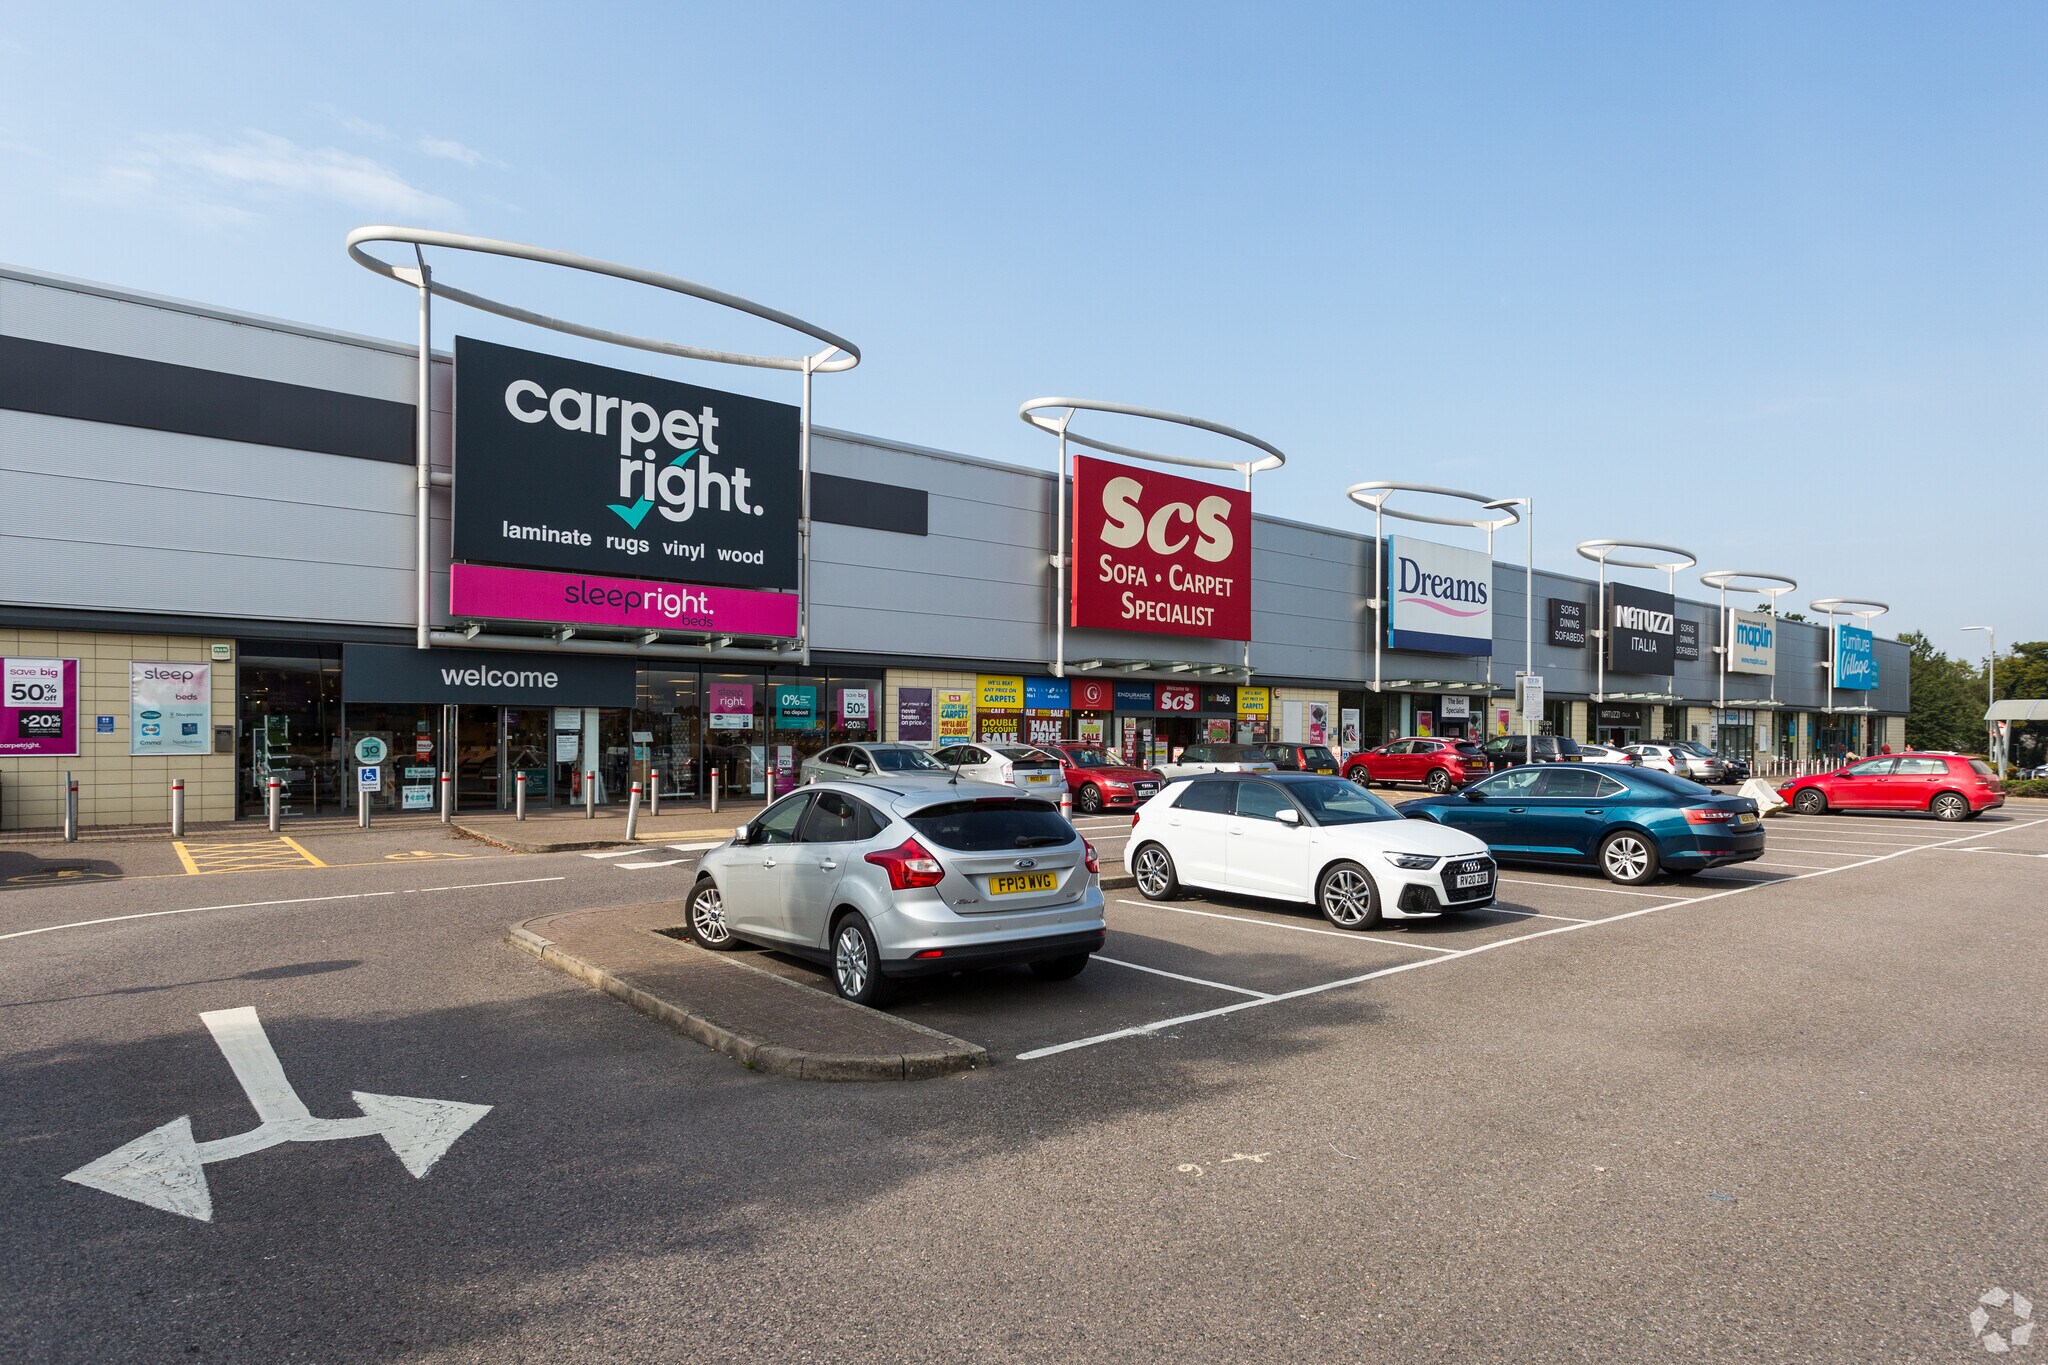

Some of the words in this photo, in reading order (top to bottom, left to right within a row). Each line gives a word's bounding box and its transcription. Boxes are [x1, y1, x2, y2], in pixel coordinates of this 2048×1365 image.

[505, 379, 719, 456] carpet
[620, 449, 764, 522] right.
[1100, 476, 1233, 562] ScS
[502, 521, 592, 546] laminate
[606, 534, 650, 555] rugs
[662, 540, 705, 561] vinyl
[717, 549, 764, 565] wood
[1398, 556, 1488, 604] Dreams
[1121, 592, 1214, 627] SPECIALIST
[1560, 604, 1580, 616] SOFAS
[681, 614, 713, 628] beds
[1559, 617, 1580, 629] DINING
[1616, 604, 1674, 635] NATUZZI
[1680, 623, 1695, 634] SOFAS
[1554, 630, 1585, 643] SOFABEDS
[1679, 635, 1695, 645] DINING
[1737, 621, 1773, 652] maplin
[1841, 630, 1871, 653] Furniture
[1631, 636, 1657, 653] ITALIA
[1676, 645, 1698, 656] SOFABEDS
[1840, 650, 1871, 682] Village
[10, 668, 36, 676] save
[40, 667, 58, 678] big
[144, 667, 194, 683] sleep
[441, 665, 558, 688] welcome
[718, 688, 743, 697] sleep
[984, 694, 1016, 703] CARPETS
[781, 694, 801, 706] 0%
[1161, 692, 1195, 710] ScS
[1242, 702, 1264, 710] CARPETS
[941, 709, 969, 719] CARPET?
[1050, 709, 1064, 717] SALE
[1601, 710, 1621, 718] NATUZZI
[982, 718, 1018, 727] DOUBLE
[1030, 720, 1062, 732] HALF
[981, 732, 1018, 743] SALE
[1030, 732, 1062, 743] PRICE
[362, 745, 380, 758] 30
[999, 877, 1026, 891] FP13
[1029, 875, 1051, 889] WVG
[1460, 874, 1476, 886] RV20
